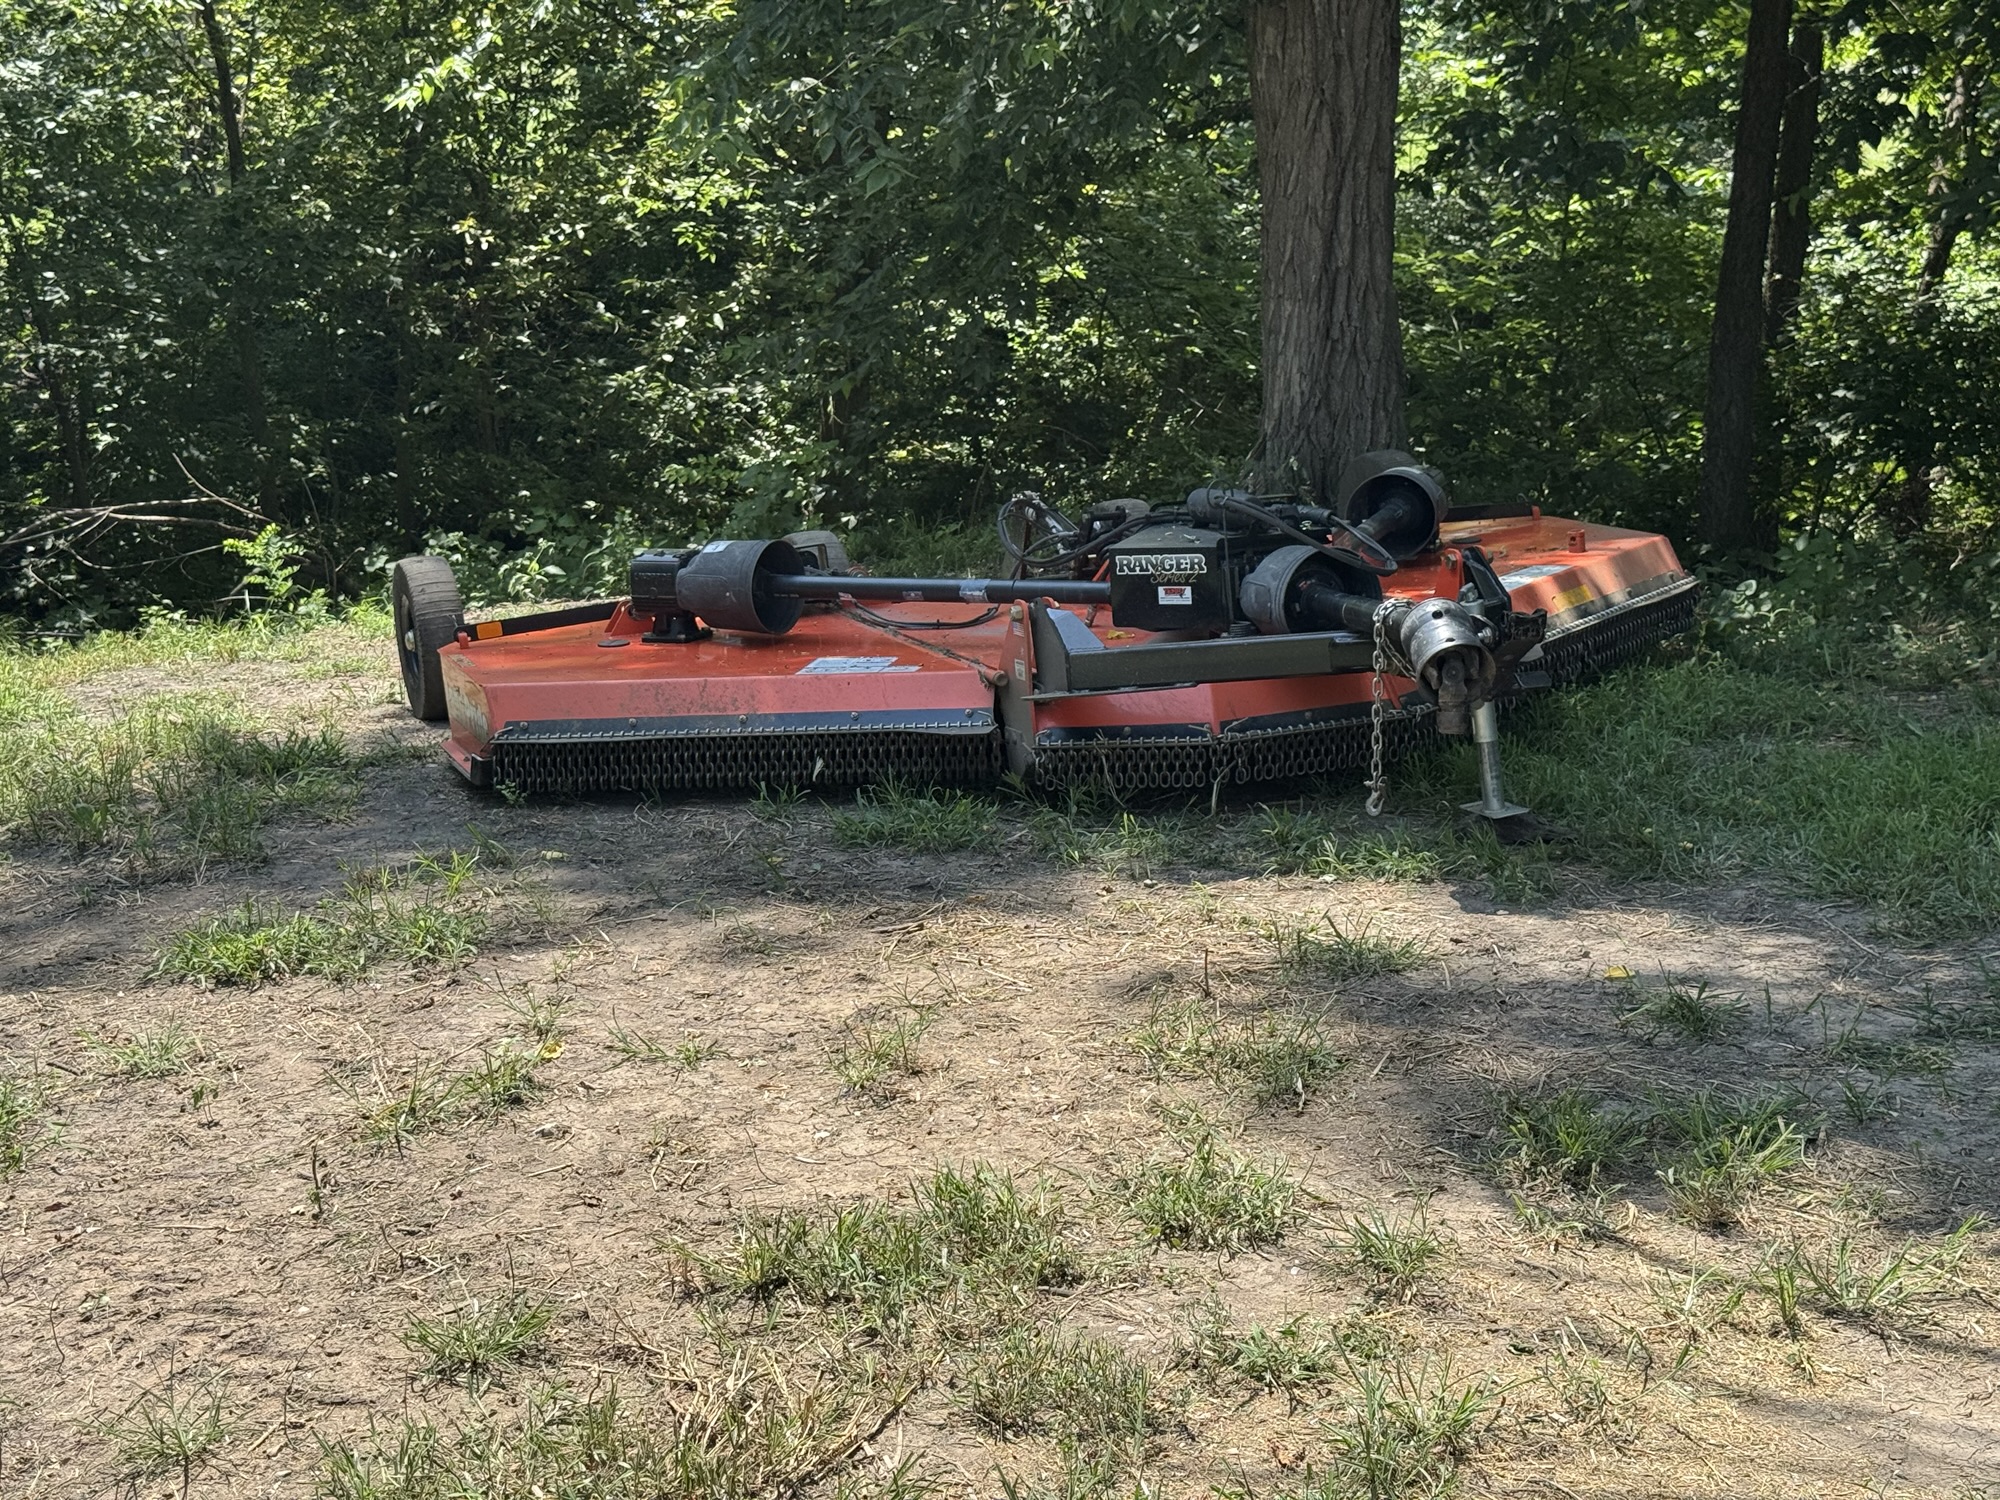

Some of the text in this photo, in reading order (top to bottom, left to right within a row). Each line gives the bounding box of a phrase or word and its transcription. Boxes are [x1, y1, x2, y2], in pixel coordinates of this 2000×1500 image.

[1115, 554, 1207, 575] RANGER
[1150, 563, 1200, 584] Series 2
